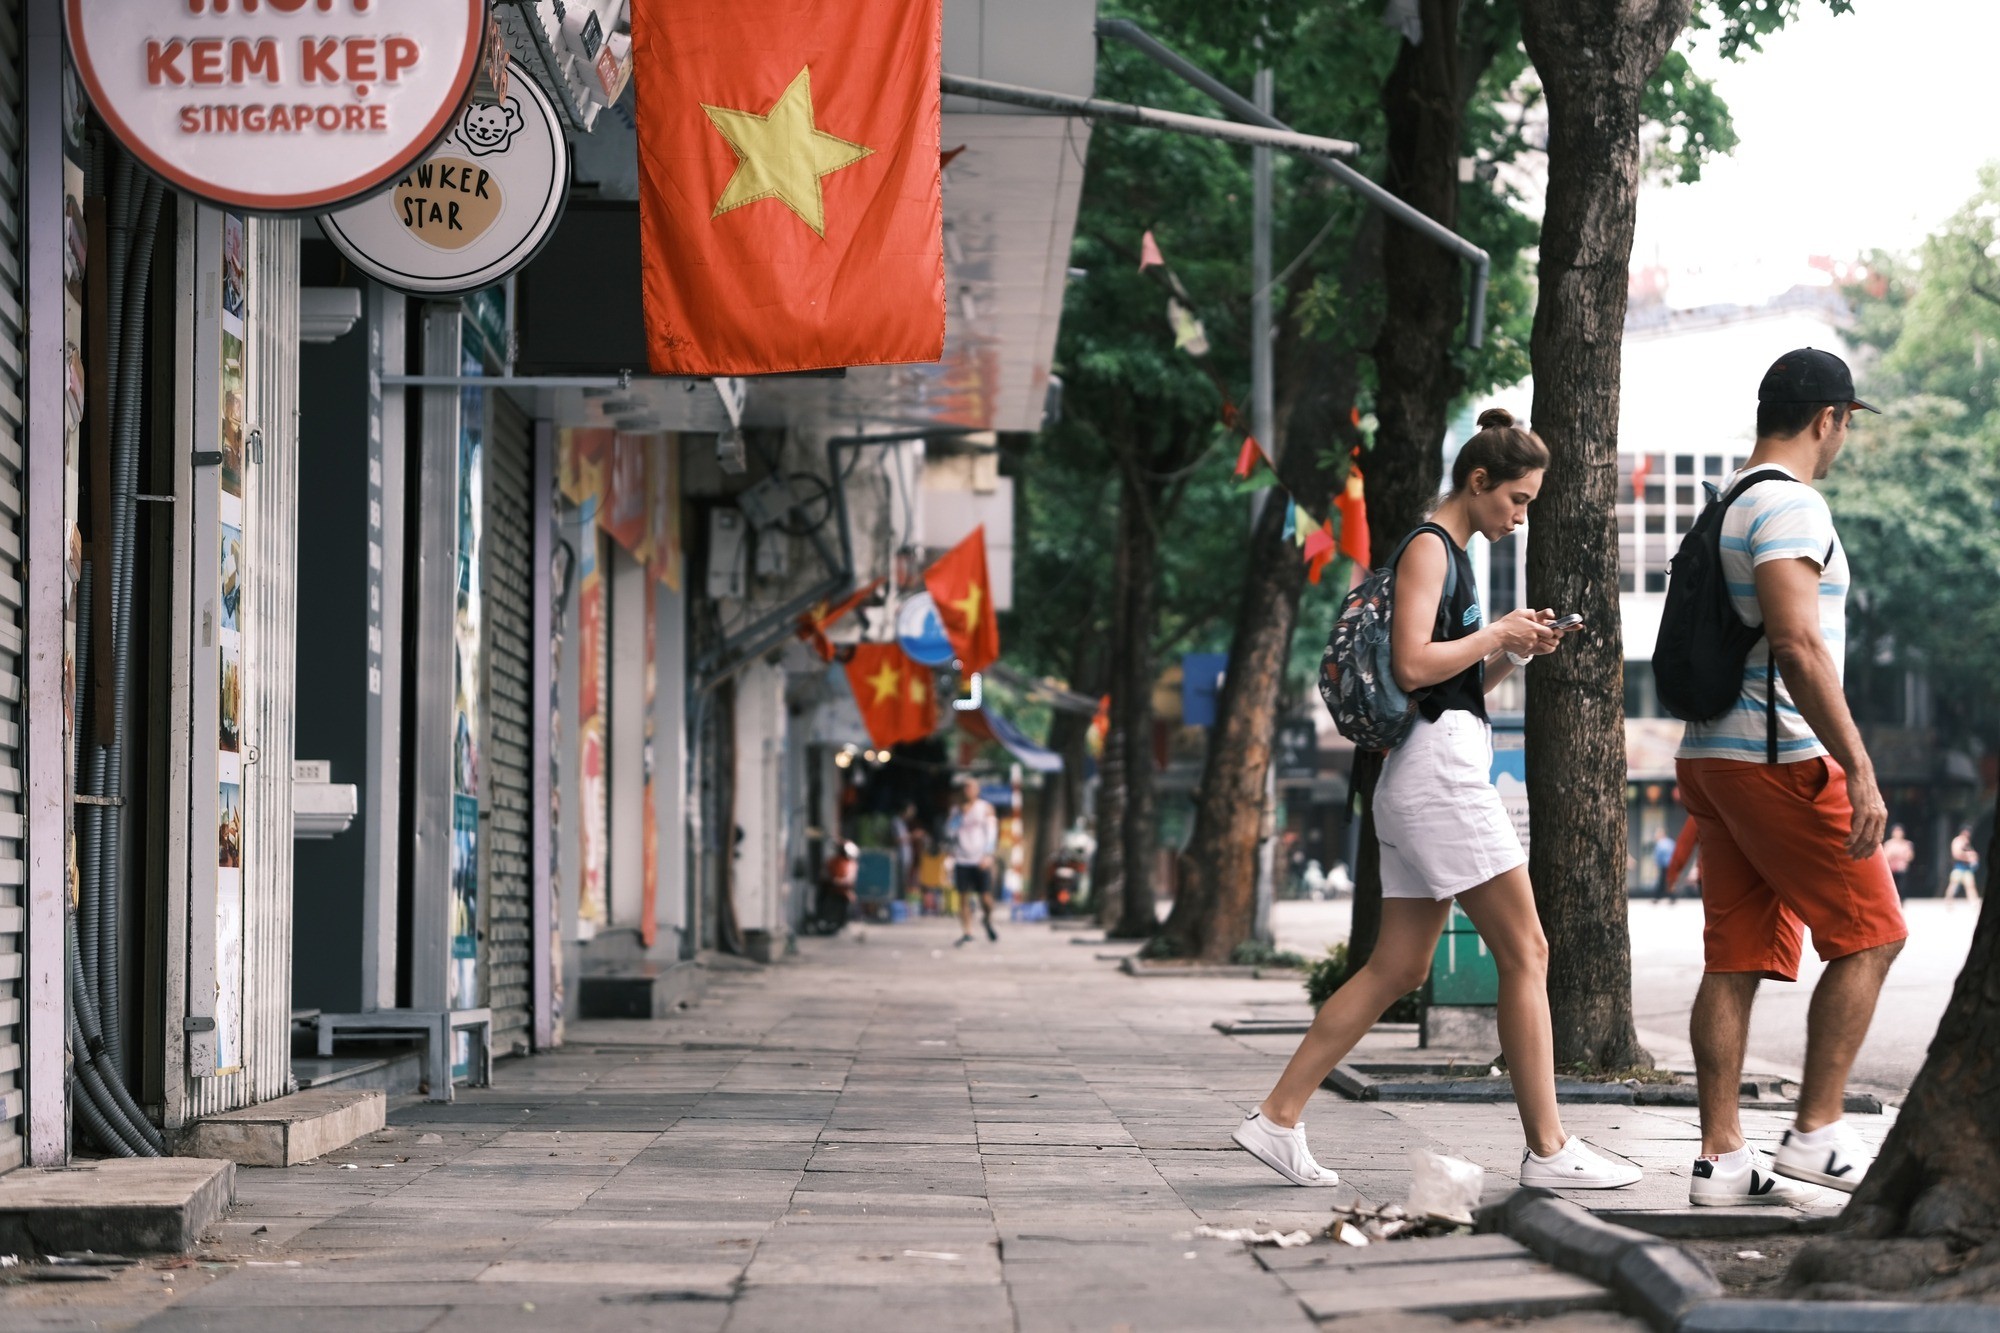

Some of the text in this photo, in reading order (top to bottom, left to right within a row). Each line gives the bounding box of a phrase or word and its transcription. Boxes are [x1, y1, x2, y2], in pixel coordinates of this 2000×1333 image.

[147, 37, 420, 97] KEM KẸP
[180, 104, 388, 133] SINGAPORE
[391, 163, 490, 200] AWKER
[403, 196, 463, 231] STAR
